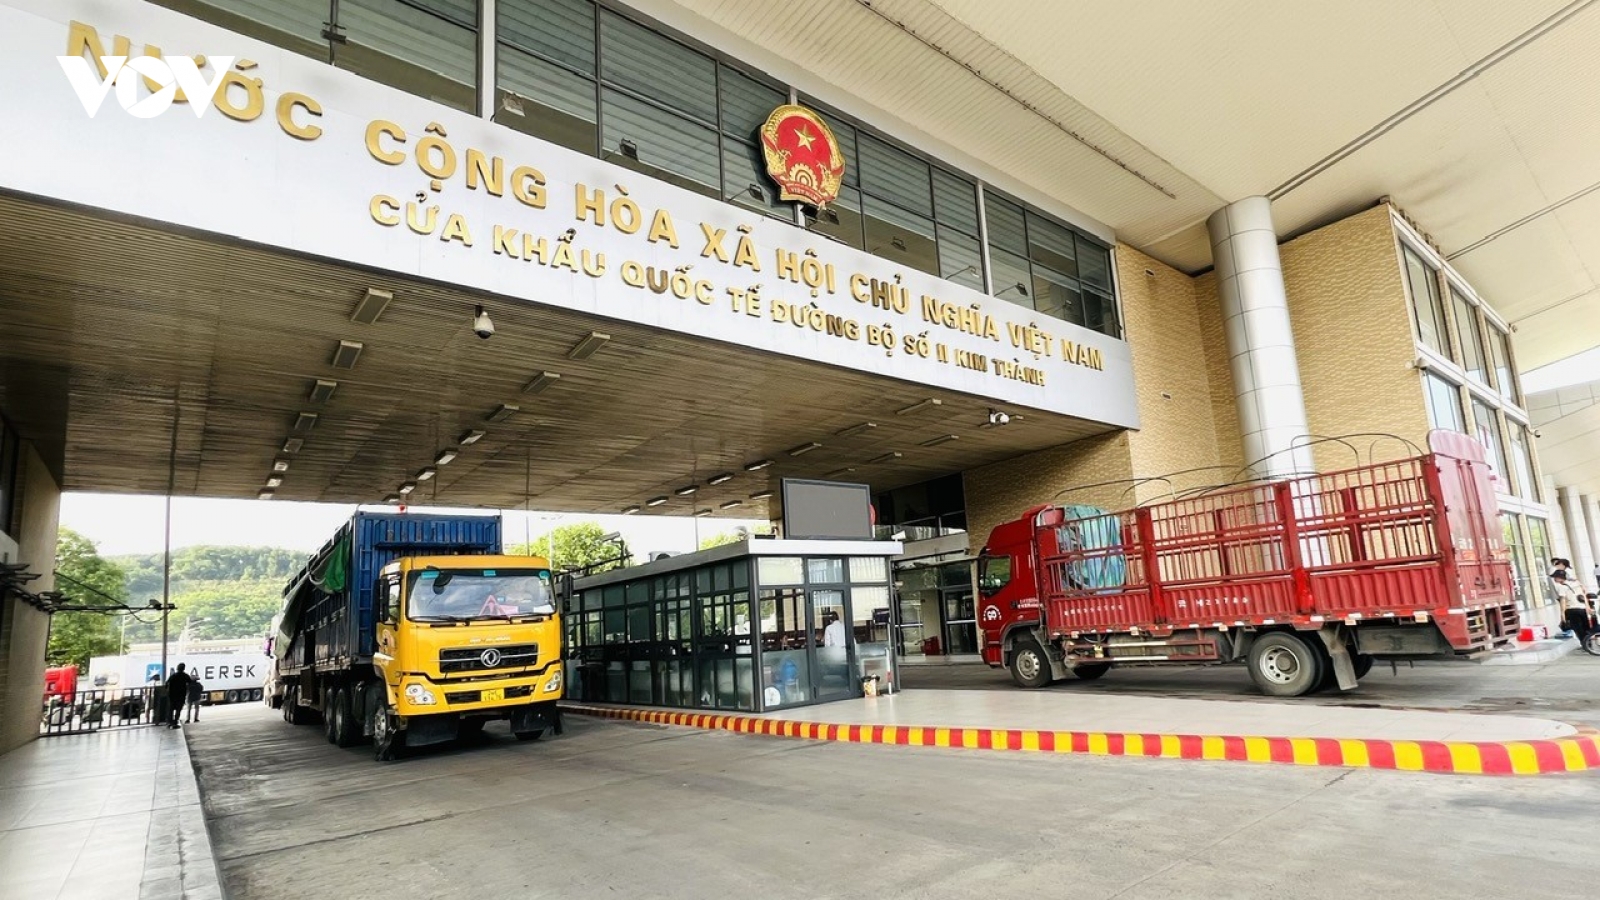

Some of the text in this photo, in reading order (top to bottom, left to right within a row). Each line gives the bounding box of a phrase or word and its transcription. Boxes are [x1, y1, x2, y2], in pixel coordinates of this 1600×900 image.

[365, 119, 547, 209] CỘNG
[575, 182, 679, 248] HÒA
[700, 223, 760, 271] XÃ
[776, 247, 836, 297] HỘI
[850, 273, 910, 314] CHỦ
[921, 294, 999, 341] NGHĨA
[1006, 321, 1053, 360] VIỆT
[1060, 338, 1104, 371] NAM
[369, 190, 473, 246] CỬA
[493, 224, 606, 276] KHẨU
[620, 264, 715, 305] QUỐC
[726, 283, 764, 317] TẾ
[770, 299, 861, 341] ĐƯỜNG
[867, 323, 897, 356] BỘ
[903, 330, 931, 358] SỐ
[954, 348, 988, 372] KIM
[991, 357, 1046, 386] THÀNH
[169, 664, 256, 680] AERSK
